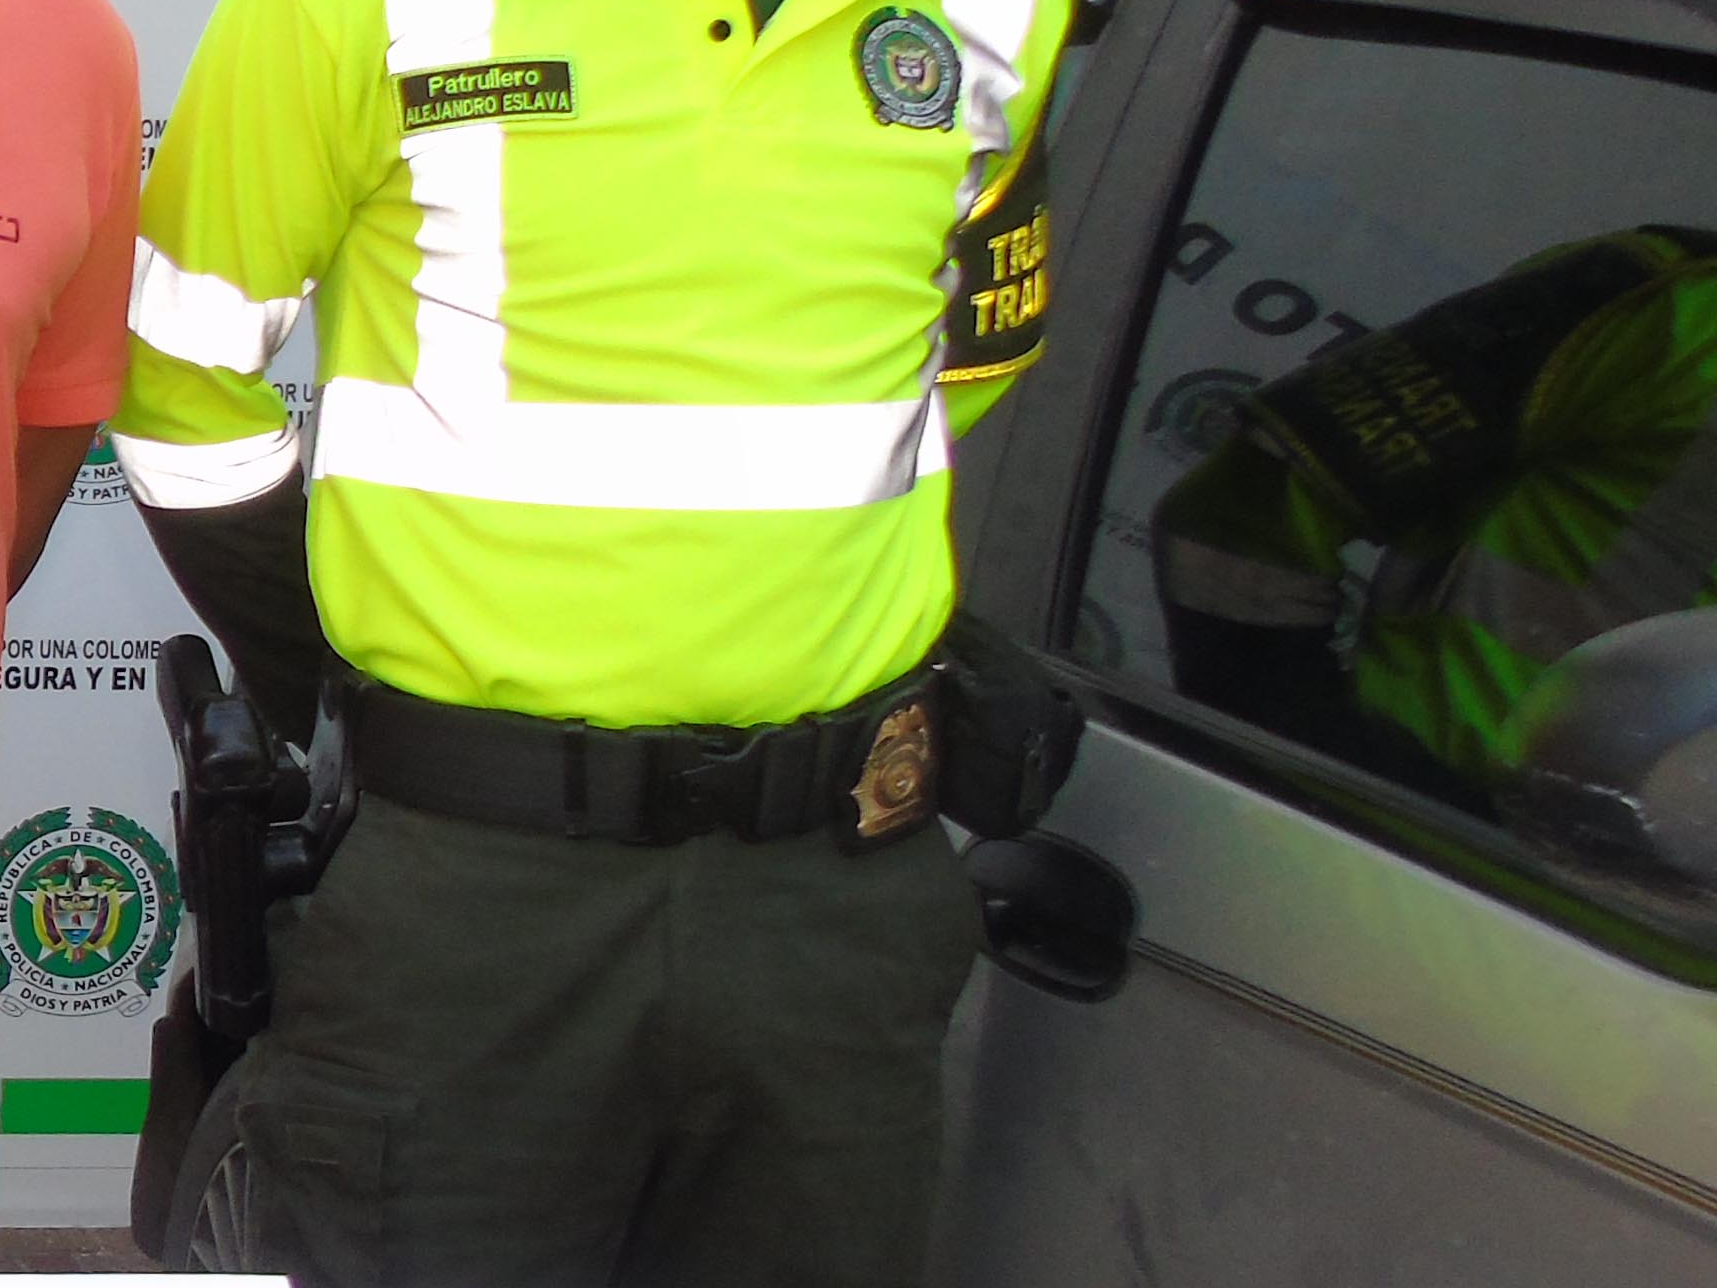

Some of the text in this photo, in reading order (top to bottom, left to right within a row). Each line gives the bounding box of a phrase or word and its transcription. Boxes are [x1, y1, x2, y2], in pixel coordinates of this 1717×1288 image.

[428, 67, 540, 98] Patrullero
[405, 91, 570, 127] ALEJANDRO ESLAVA
[3, 639, 162, 660] OR UNA COLOMB
[87, 667, 103, 691] Y
[112, 667, 146, 691] EN
[70, 831, 92, 843] DE
[109, 840, 156, 925] COLOMBIA
[74, 943, 148, 992] NACIONAL
[20, 987, 127, 1012] DIOS Y PATRIA
